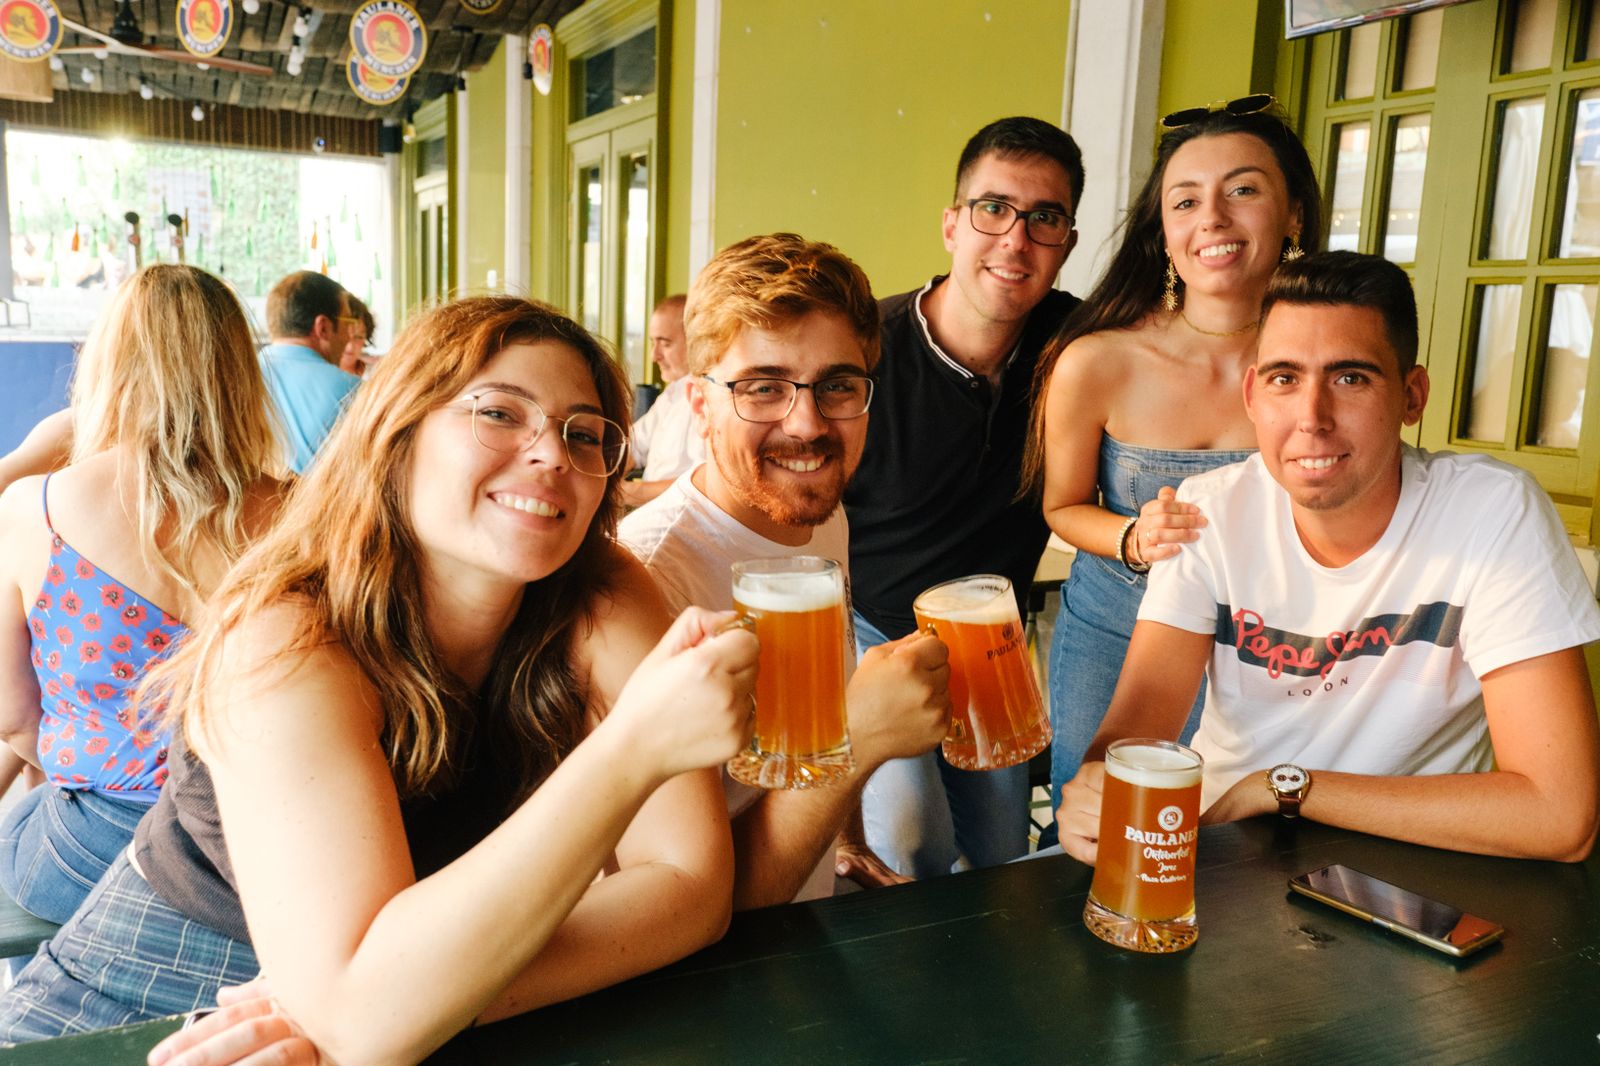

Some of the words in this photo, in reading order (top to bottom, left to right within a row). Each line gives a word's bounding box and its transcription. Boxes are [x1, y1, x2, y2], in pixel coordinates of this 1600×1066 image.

[354, 1, 420, 29] PAULANER
[986, 631, 1025, 660] PAULA
[1232, 608, 1320, 679] Pepe
